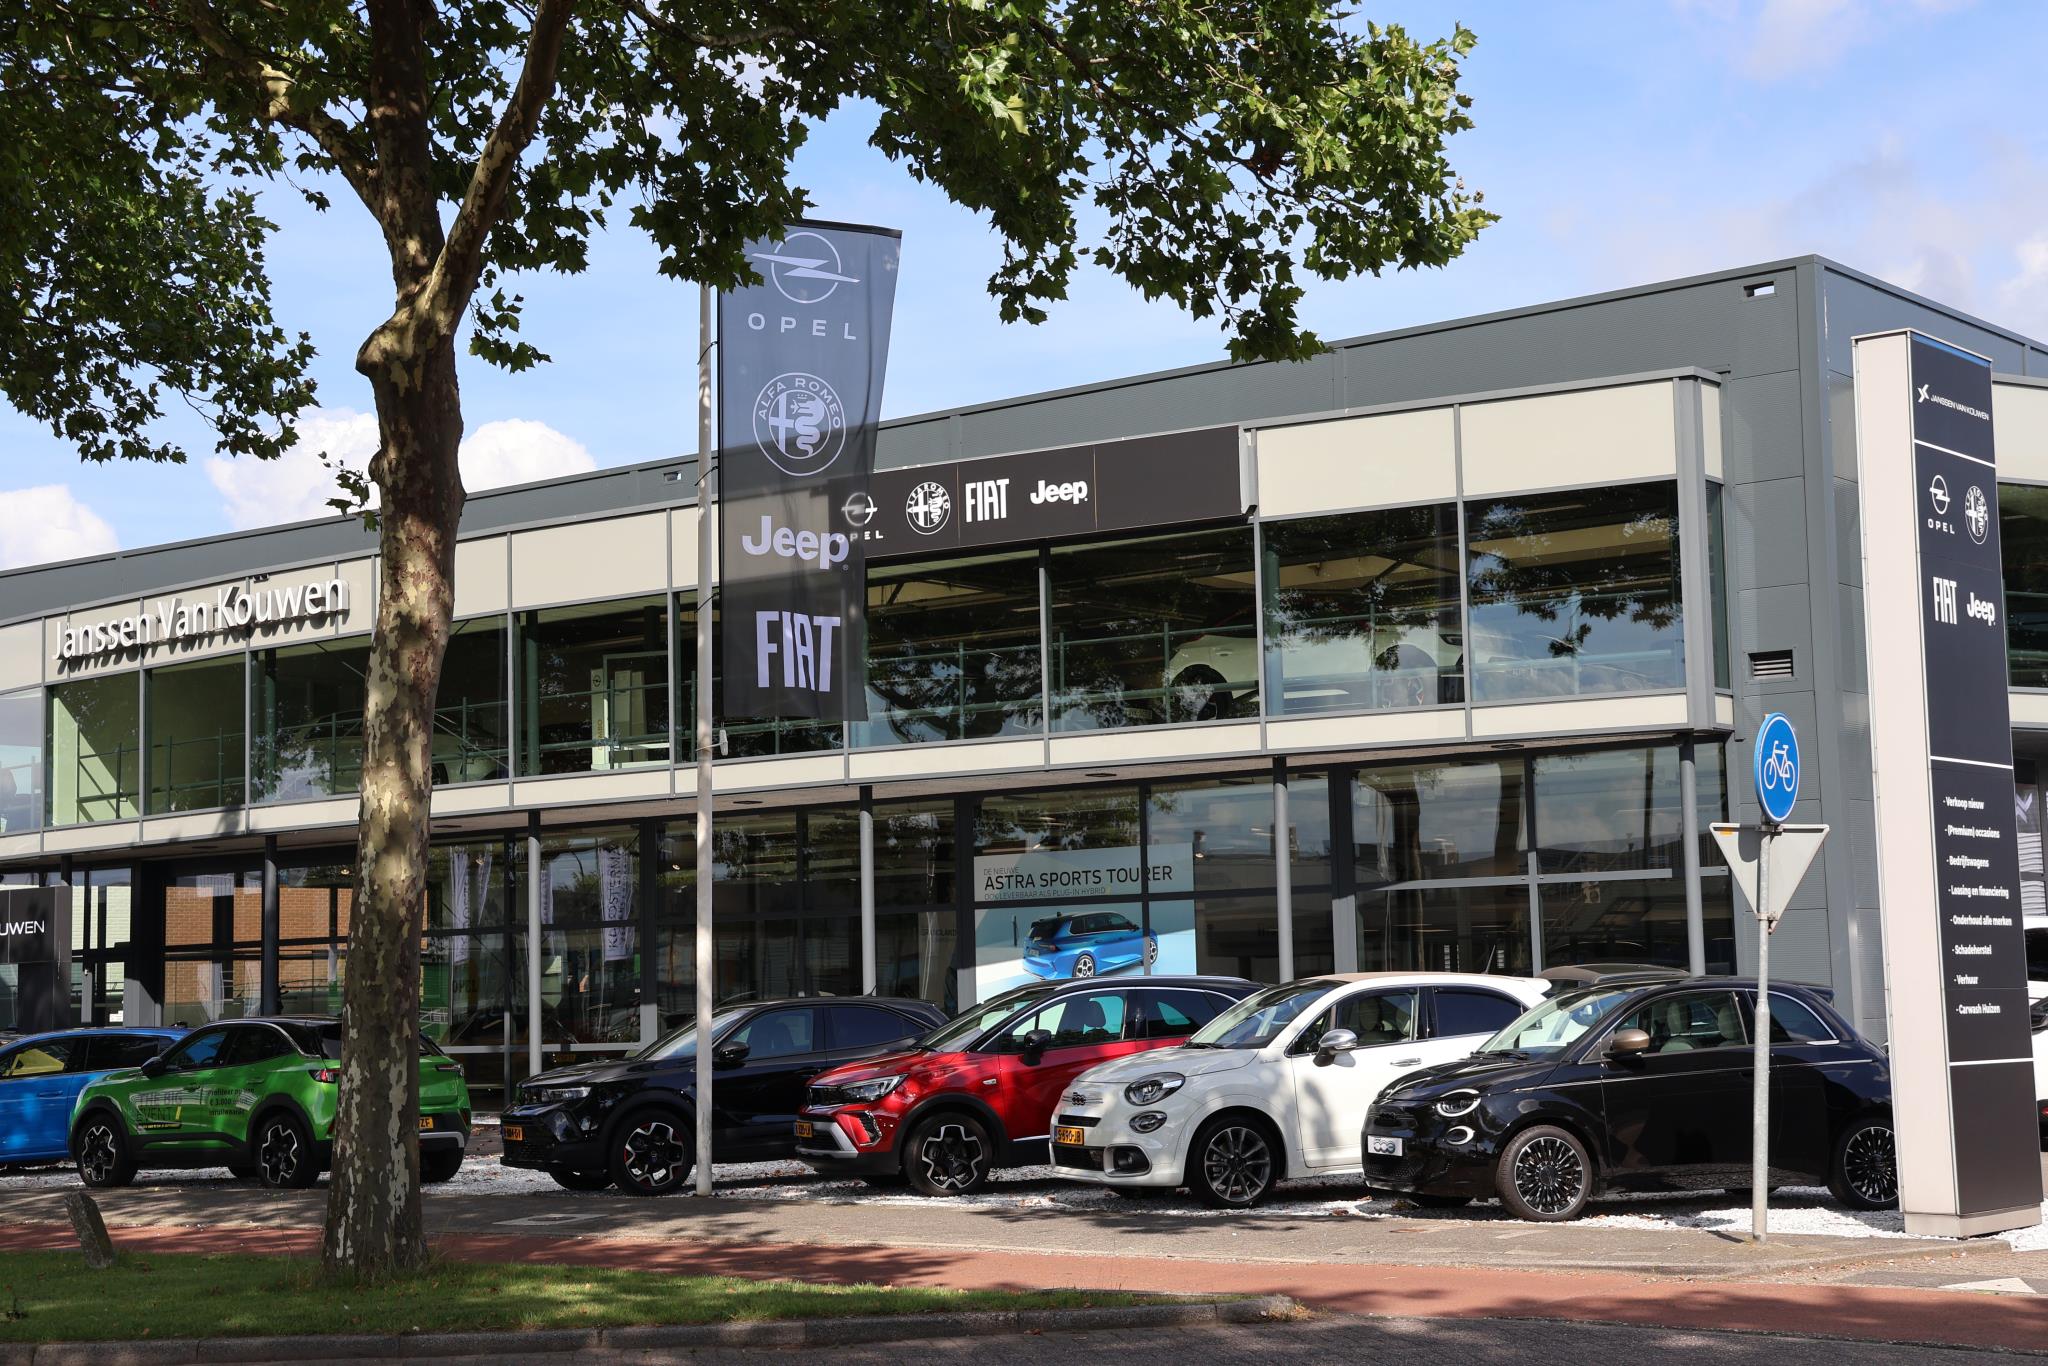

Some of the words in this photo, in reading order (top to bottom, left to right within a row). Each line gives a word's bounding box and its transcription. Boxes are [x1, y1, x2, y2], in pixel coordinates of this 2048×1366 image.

[747, 312, 858, 341] OPEL
[758, 381, 787, 421] ALFA
[794, 377, 842, 429] ROMEO
[1930, 394, 1956, 409] JANSSEN
[1965, 407, 1990, 421] KOUWEN
[965, 478, 1010, 523] FIAT
[1029, 480, 1089, 505] Jeep
[1927, 518, 1956, 535] OPEL
[742, 515, 850, 570] Jeep
[1932, 576, 1958, 625] FIAT
[1966, 591, 1996, 627] Jeep
[52, 614, 154, 661] Janssen
[157, 597, 212, 640] Van
[216, 577, 350, 630] Kouwen
[755, 610, 841, 692] FIAT
[1945, 796, 1968, 811] Verkoop
[1968, 797, 1985, 810] nieuw
[1947, 824, 1975, 838] (Premium)
[1975, 826, 2000, 839] occasions
[983, 868, 993, 876] DE
[993, 866, 1020, 876] NIEUWE
[1948, 854, 1989, 870] Bedrijfswagens
[984, 873, 1036, 891] ASTRA
[1039, 870, 1102, 889] SPORTS
[1000, 891, 1037, 900] LEVERBAAR
[1038, 889, 1052, 898] ALS
[1052, 888, 1080, 897] PLUG-IN
[1081, 886, 1106, 895] HYBRID
[1950, 884, 1971, 898] Leasing
[1971, 887, 1979, 896] en
[1979, 885, 2010, 900] financiering
[1952, 914, 1983, 926] Onderhoud
[1983, 914, 1993, 926] alle
[1993, 915, 2013, 927] merken
[1954, 944, 1993, 955] Schadeherstel
[1956, 974, 1979, 985] Verhuur
[1958, 1003, 1982, 1015] Carwash
[1981, 1002, 2001, 1014] Huizen
